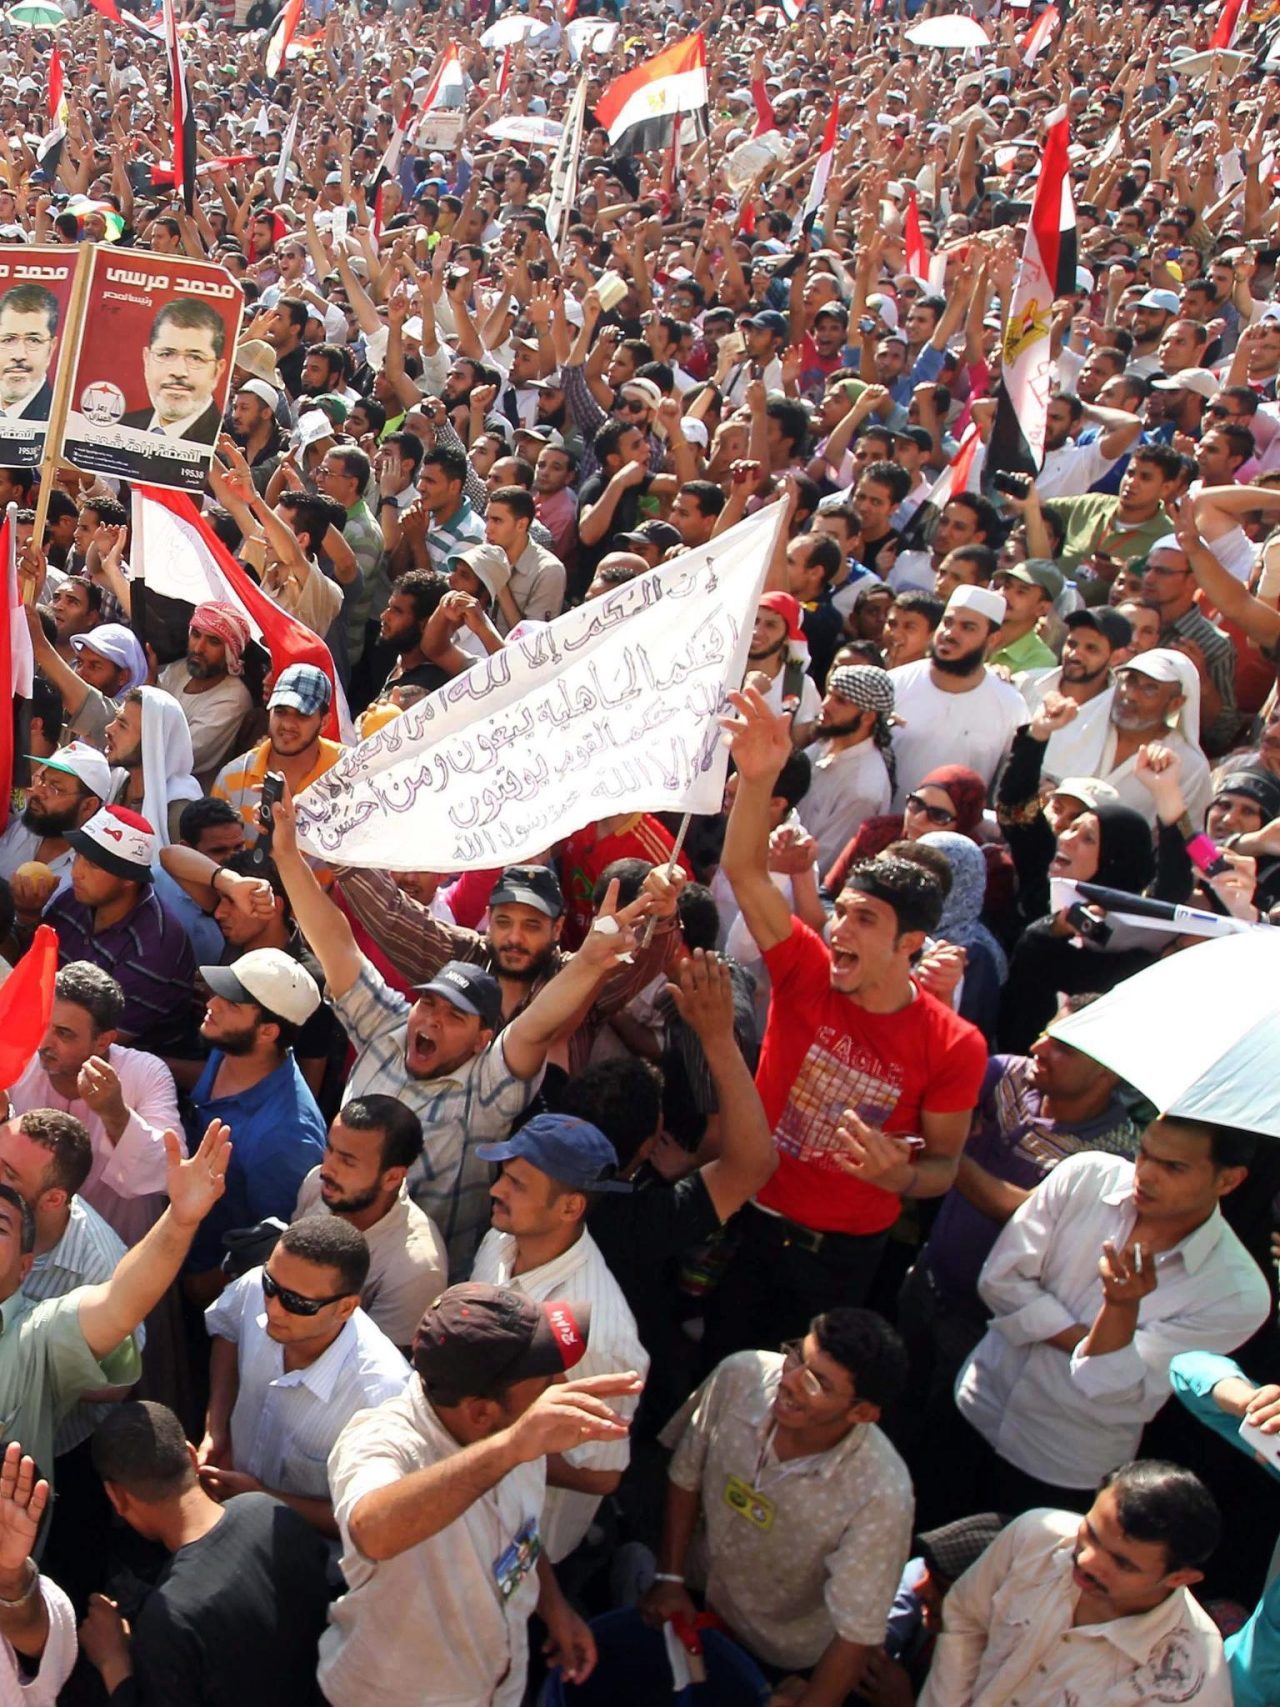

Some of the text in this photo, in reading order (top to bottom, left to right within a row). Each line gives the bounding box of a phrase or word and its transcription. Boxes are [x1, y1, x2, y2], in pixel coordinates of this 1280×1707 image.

[13, 265, 69, 280] محمد
[173, 276, 235, 299] محمد
[180, 467, 205, 479] 19538
